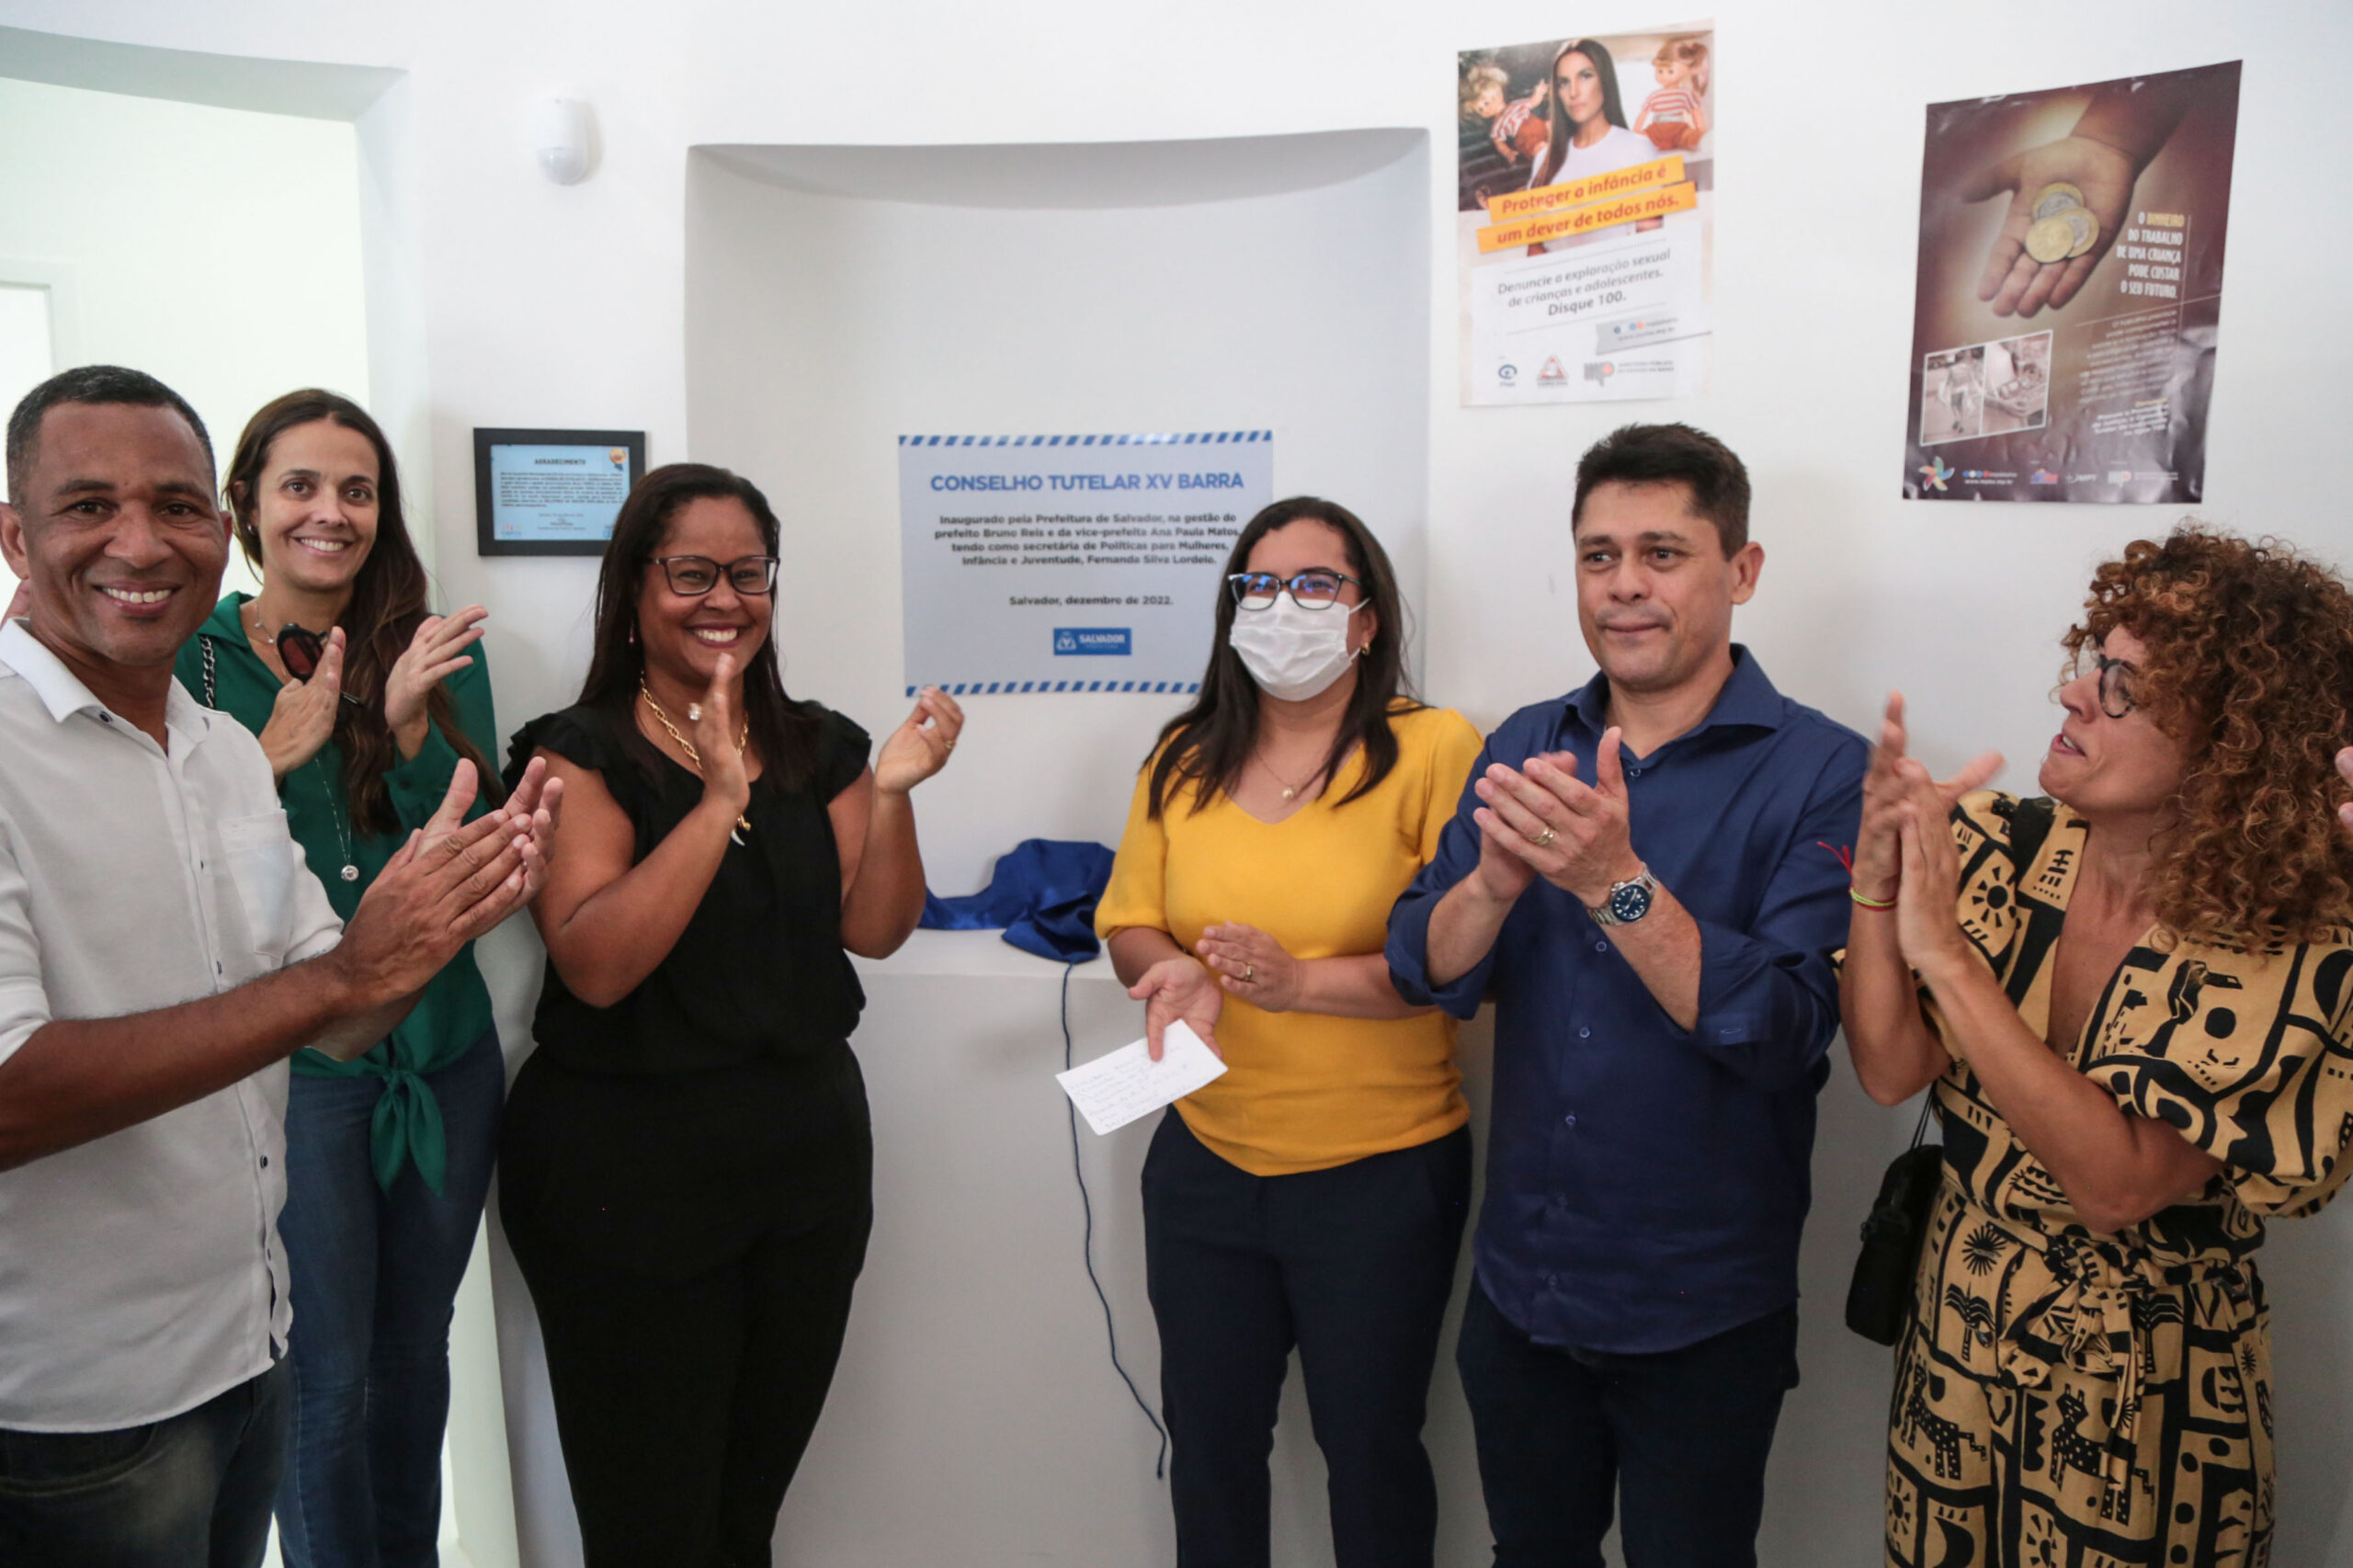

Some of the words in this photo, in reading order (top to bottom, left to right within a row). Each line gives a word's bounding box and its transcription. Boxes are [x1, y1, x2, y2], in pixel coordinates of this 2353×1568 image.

[1502, 188, 1572, 213] Proteger
[1574, 187, 1585, 199] a
[1588, 168, 1653, 195] infância
[1657, 164, 1666, 178] é
[1497, 230, 1522, 244] um
[1526, 219, 1572, 238] dever
[1574, 213, 1593, 229] de
[1597, 204, 1642, 222] todos
[1645, 194, 1679, 213] nós.
[2138, 211, 2145, 224] O
[2128, 229, 2140, 242] DO
[2142, 229, 2183, 245] TRABALHO
[2116, 244, 2127, 258] DE
[2128, 245, 2146, 260] UMA
[2148, 247, 2181, 265] CRIANÇA
[1498, 273, 1552, 295] Denuncie
[1555, 274, 1563, 283] a
[1564, 258, 1630, 285] exploração
[1631, 248, 1671, 267] sexual
[2128, 263, 2149, 278] PODE
[2151, 266, 2180, 280] CUSTAR
[1508, 295, 1522, 308] de
[1525, 288, 1573, 305] crianças
[1575, 285, 1582, 294] e
[1585, 267, 1664, 294] adolescentes.
[2120, 279, 2128, 293] O
[2129, 280, 2143, 295] SEU
[2144, 282, 2177, 299] FUTURO.
[1548, 298, 1594, 316] Disque
[1599, 290, 1626, 304] 100.
[931, 475, 1043, 491] CONSELHO
[1049, 474, 1140, 490] TUTELAR
[1146, 473, 1173, 489] XV
[1177, 472, 1245, 489] BARRA
[939, 515, 1005, 525] Inaugurado
[1008, 515, 1032, 525] pela
[1036, 514, 1092, 524] Prefeitura
[1096, 514, 1109, 523] de
[1113, 513, 1165, 524] Salvador,
[1168, 515, 1181, 523] na
[1184, 513, 1220, 524] gestão
[1223, 513, 1236, 522] do
[935, 528, 980, 540] prefeito
[983, 528, 1017, 538] Bruno
[1020, 528, 1044, 537] Reis
[1058, 528, 1072, 537] da
[1075, 527, 1147, 539] vice-prefeita
[1151, 527, 1172, 536] Ana
[1176, 527, 1204, 536] Paula
[951, 542, 984, 551] tendo
[988, 543, 1019, 551] como
[1023, 541, 1079, 551] secretária
[1083, 541, 1096, 551] de
[1100, 540, 1147, 551] Políticas
[1151, 542, 1176, 551] para
[1178, 540, 1229, 551] Mulheres,
[962, 555, 1007, 565] Infância
[1021, 555, 1084, 565] Juventude,
[1087, 555, 1140, 564] Fernanda
[1143, 555, 1169, 564] Silva
[1173, 554, 1217, 564] Lordelo.
[1009, 597, 1063, 606] Salvador,
[1065, 596, 1121, 605] dezembro
[1126, 596, 1139, 605] de
[1142, 596, 1174, 605] 2022.
[1079, 634, 1126, 643] SALVADOR
